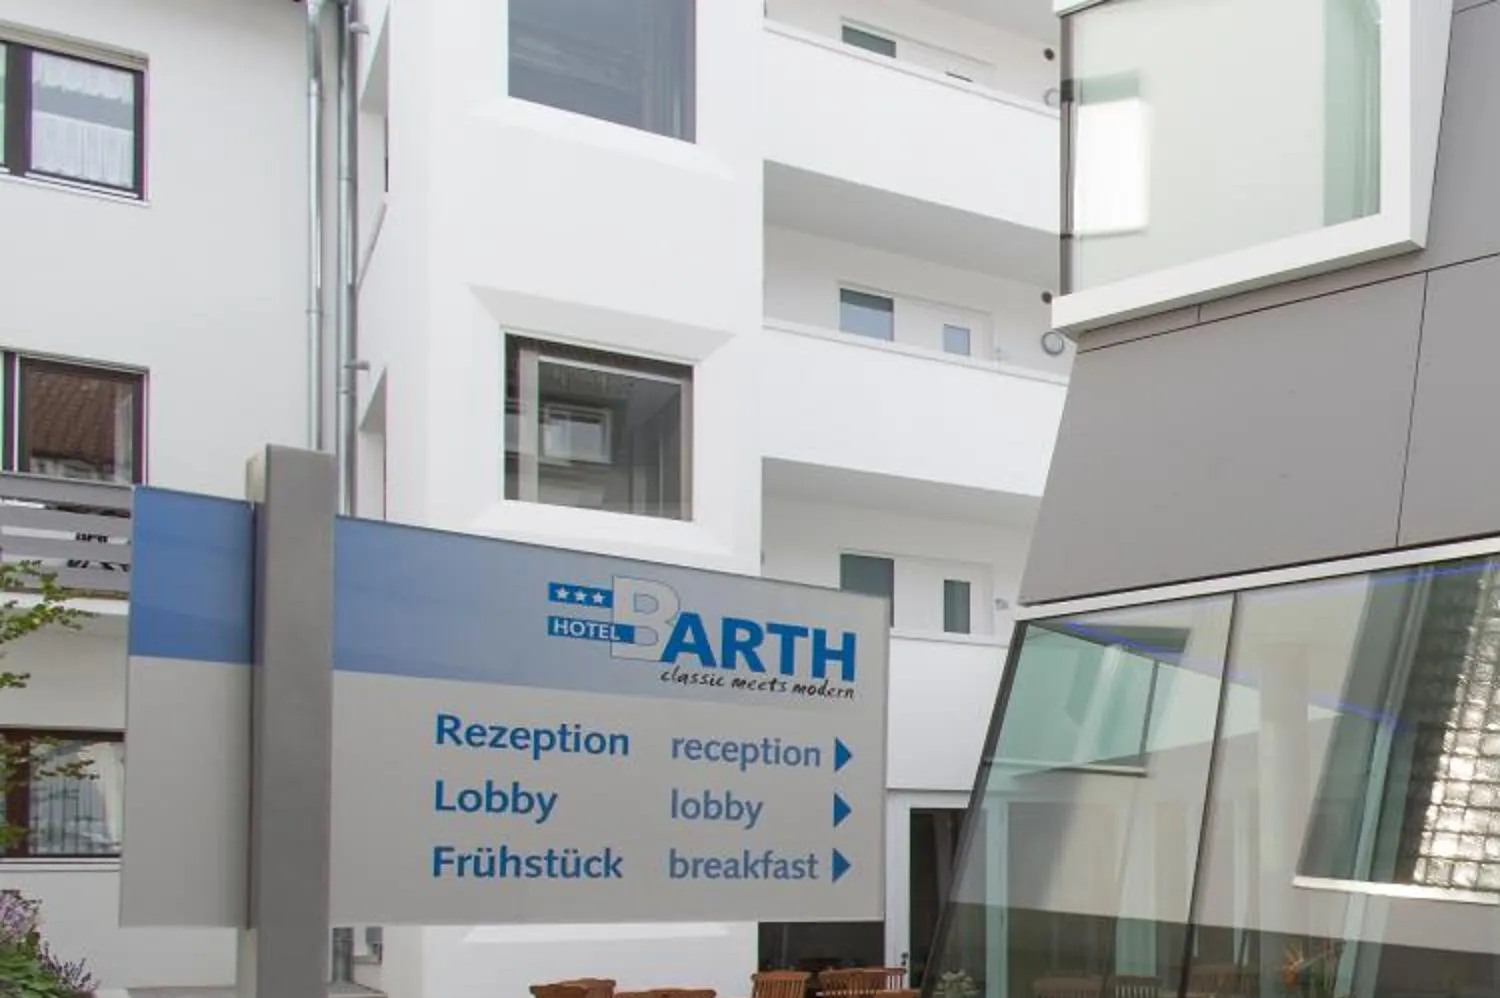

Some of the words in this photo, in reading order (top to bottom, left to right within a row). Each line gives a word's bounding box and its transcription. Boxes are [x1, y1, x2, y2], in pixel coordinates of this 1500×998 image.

[553, 617, 621, 641] HOTEL
[610, 575, 856, 681] BARTH
[660, 664, 725, 686] classic
[731, 676, 787, 694] meets
[792, 677, 855, 699] modern
[435, 713, 630, 761] Rezeption
[671, 735, 821, 772] reception
[434, 779, 559, 824] Lobby
[670, 788, 763, 830] lobby
[431, 845, 625, 879] Frühstück
[669, 848, 820, 880] breakfast
